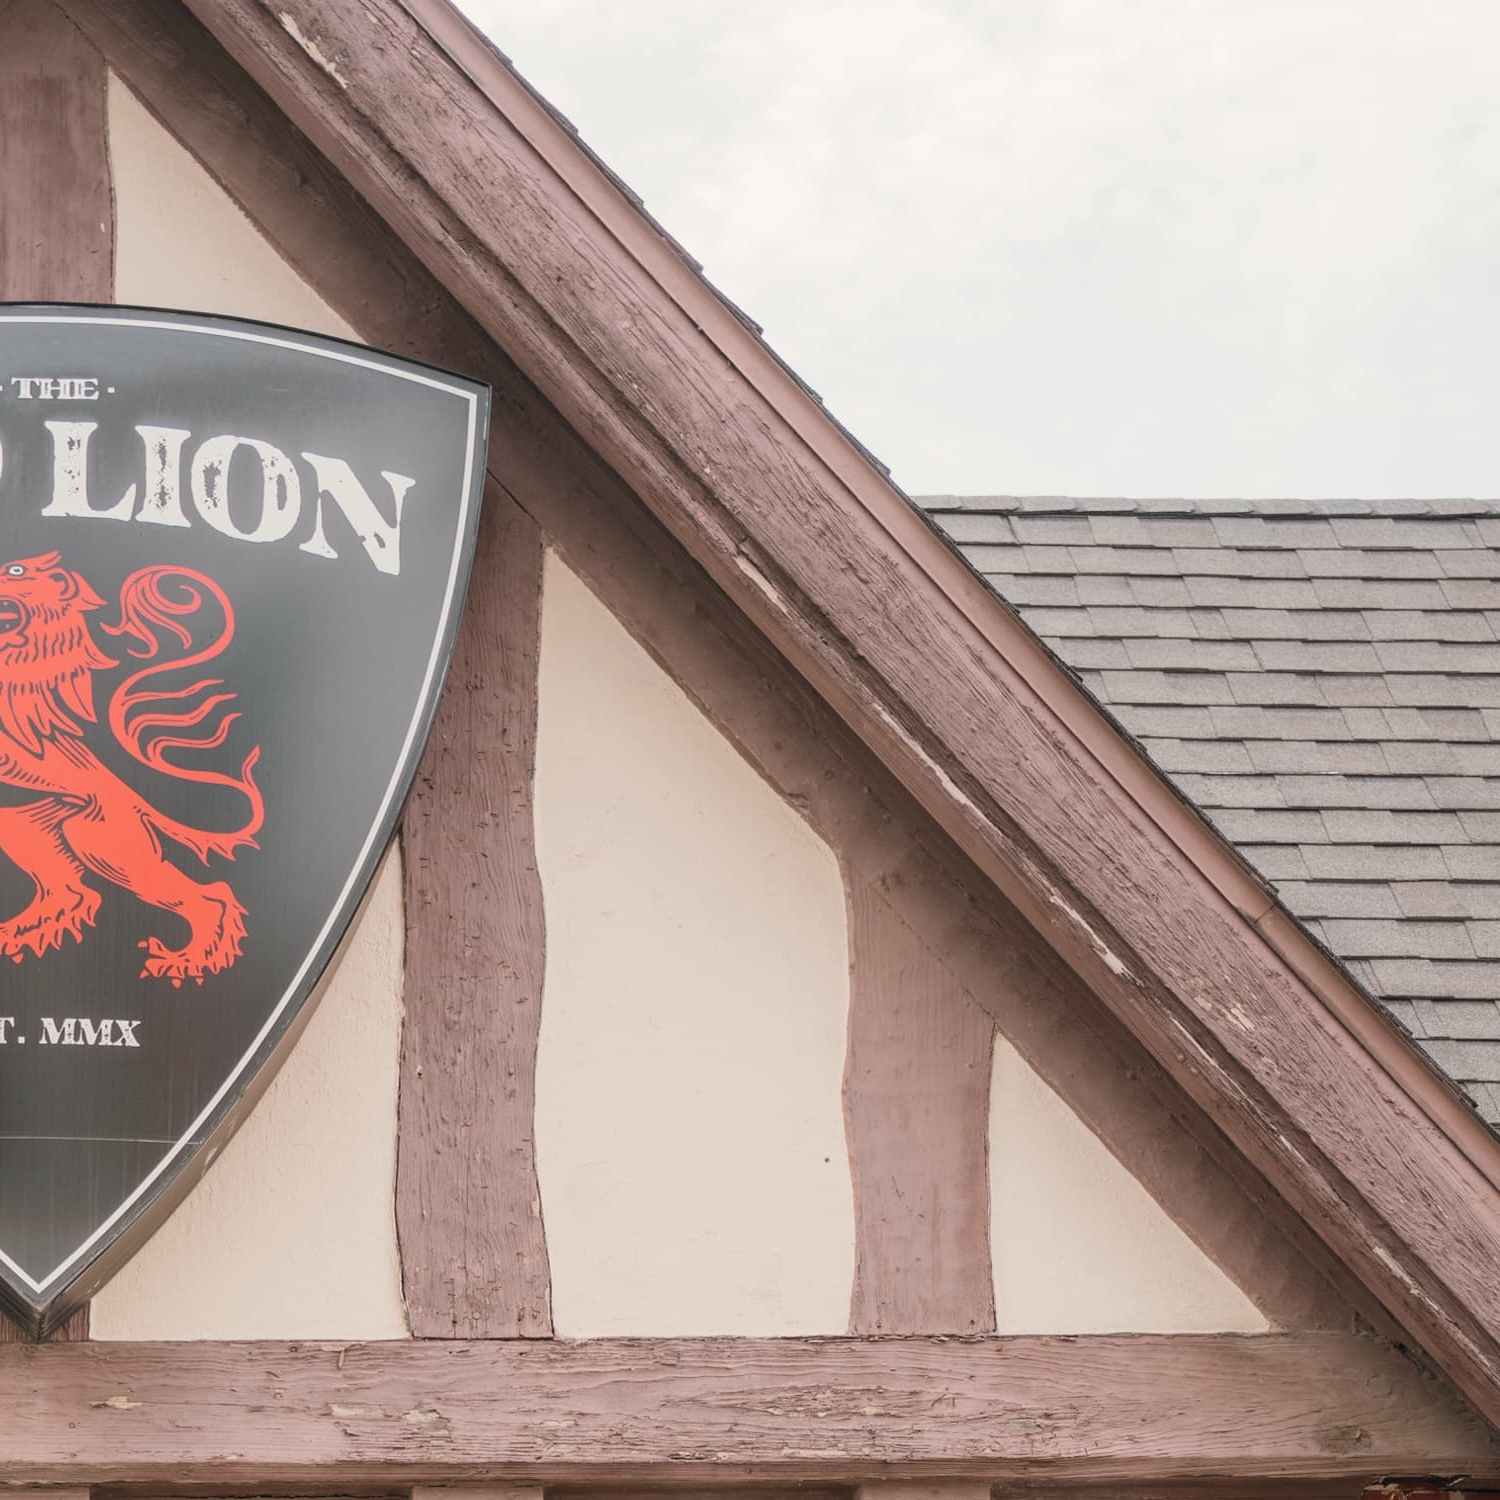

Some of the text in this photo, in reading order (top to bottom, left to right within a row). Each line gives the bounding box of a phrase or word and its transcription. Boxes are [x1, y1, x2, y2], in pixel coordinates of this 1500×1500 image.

[11, 377, 99, 400] THE
[41, 420, 416, 576] LION
[38, 1017, 141, 1047] MMX
